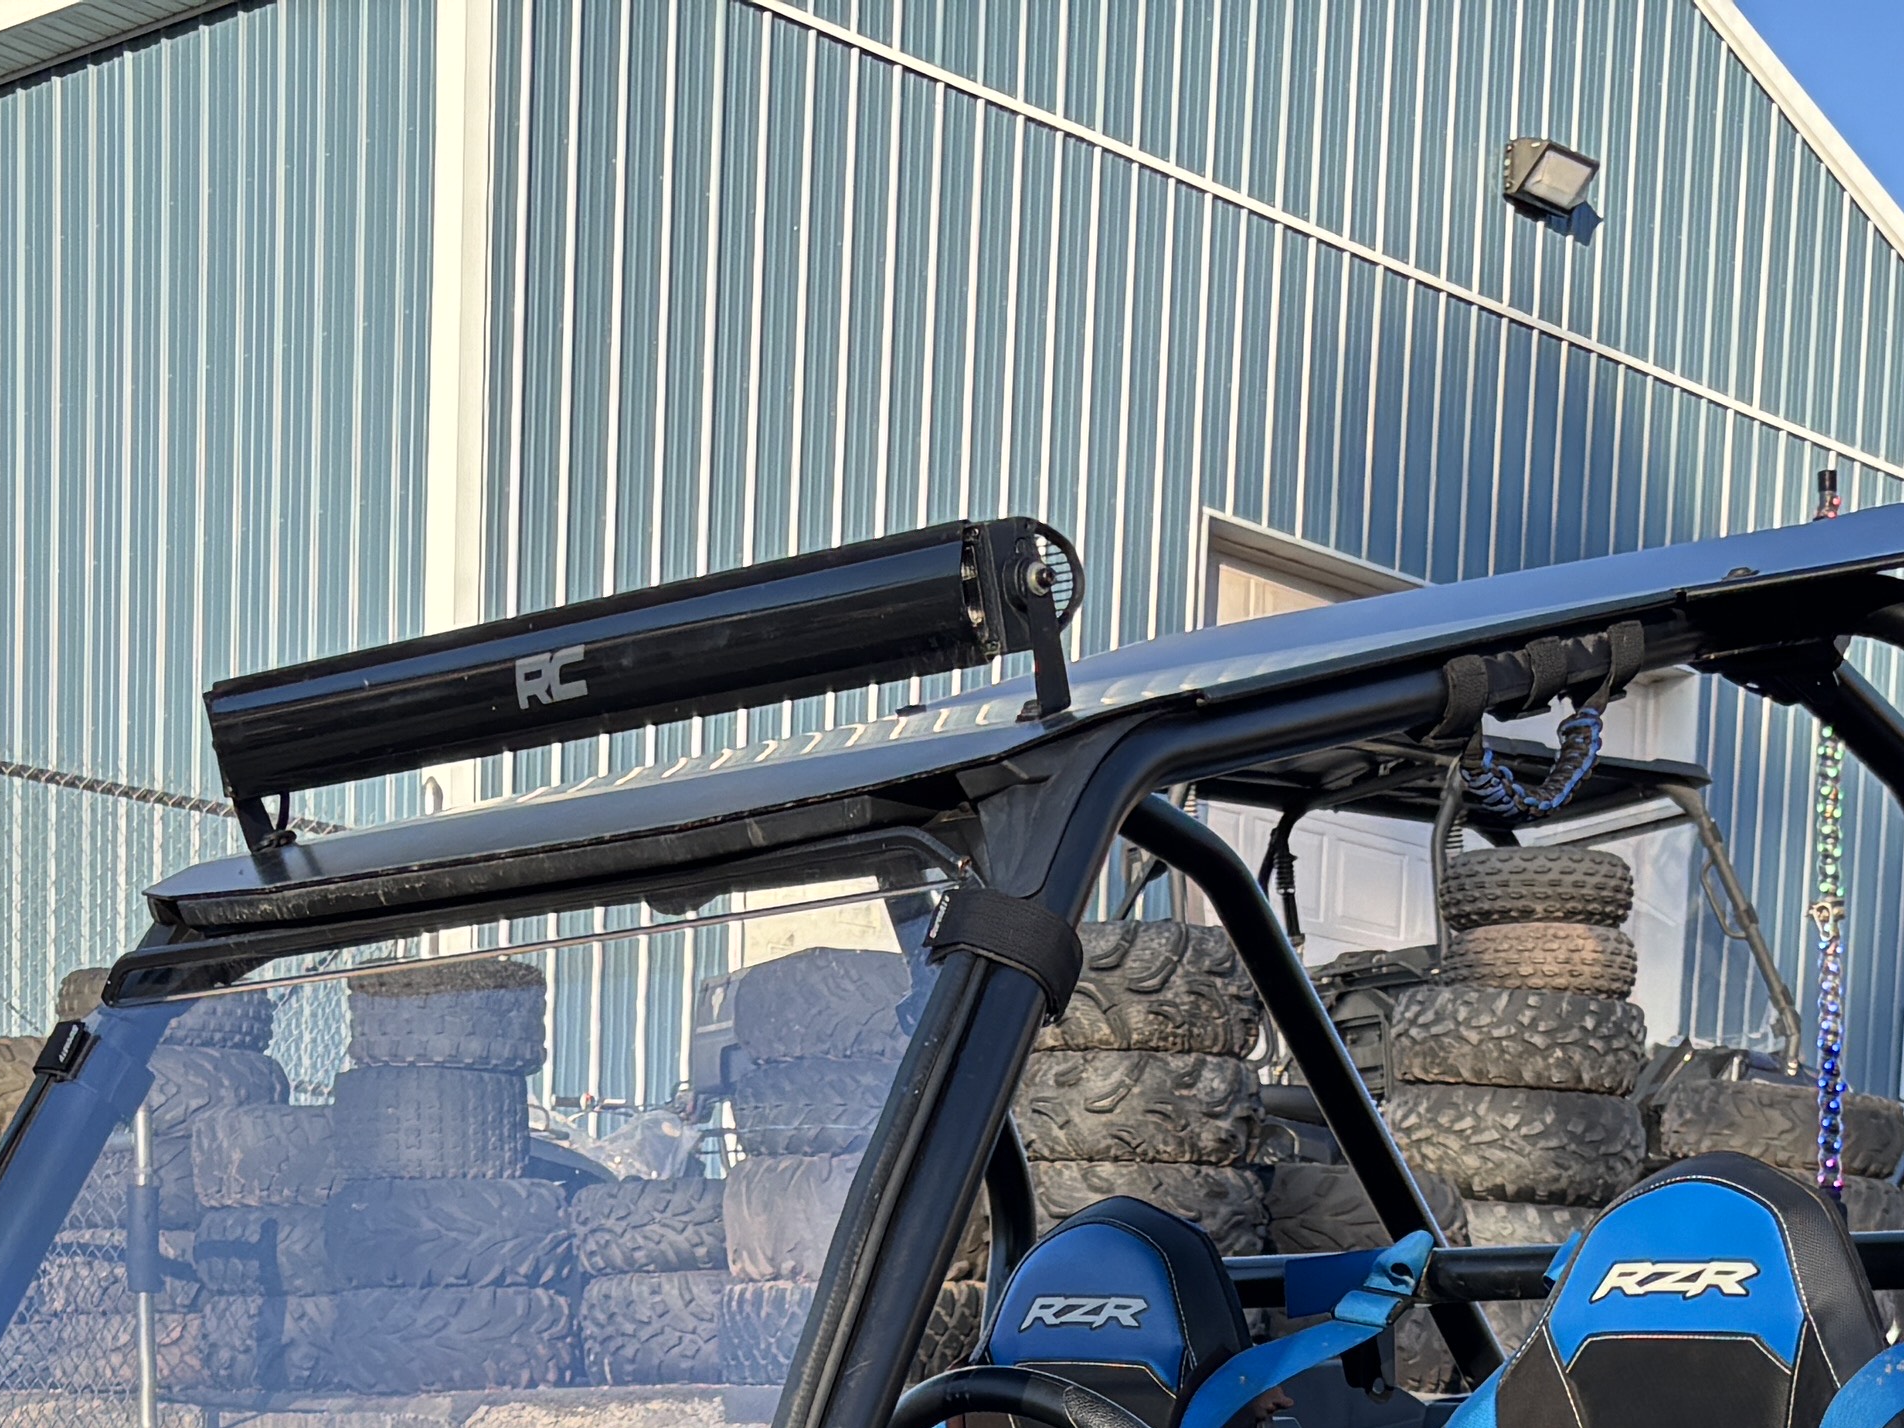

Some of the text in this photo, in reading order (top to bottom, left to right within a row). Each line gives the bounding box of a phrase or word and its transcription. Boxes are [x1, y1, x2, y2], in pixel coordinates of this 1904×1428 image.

[515, 644, 589, 710] RC
[1588, 1257, 1761, 1303] RZR
[1018, 1294, 1149, 1333] RZR
